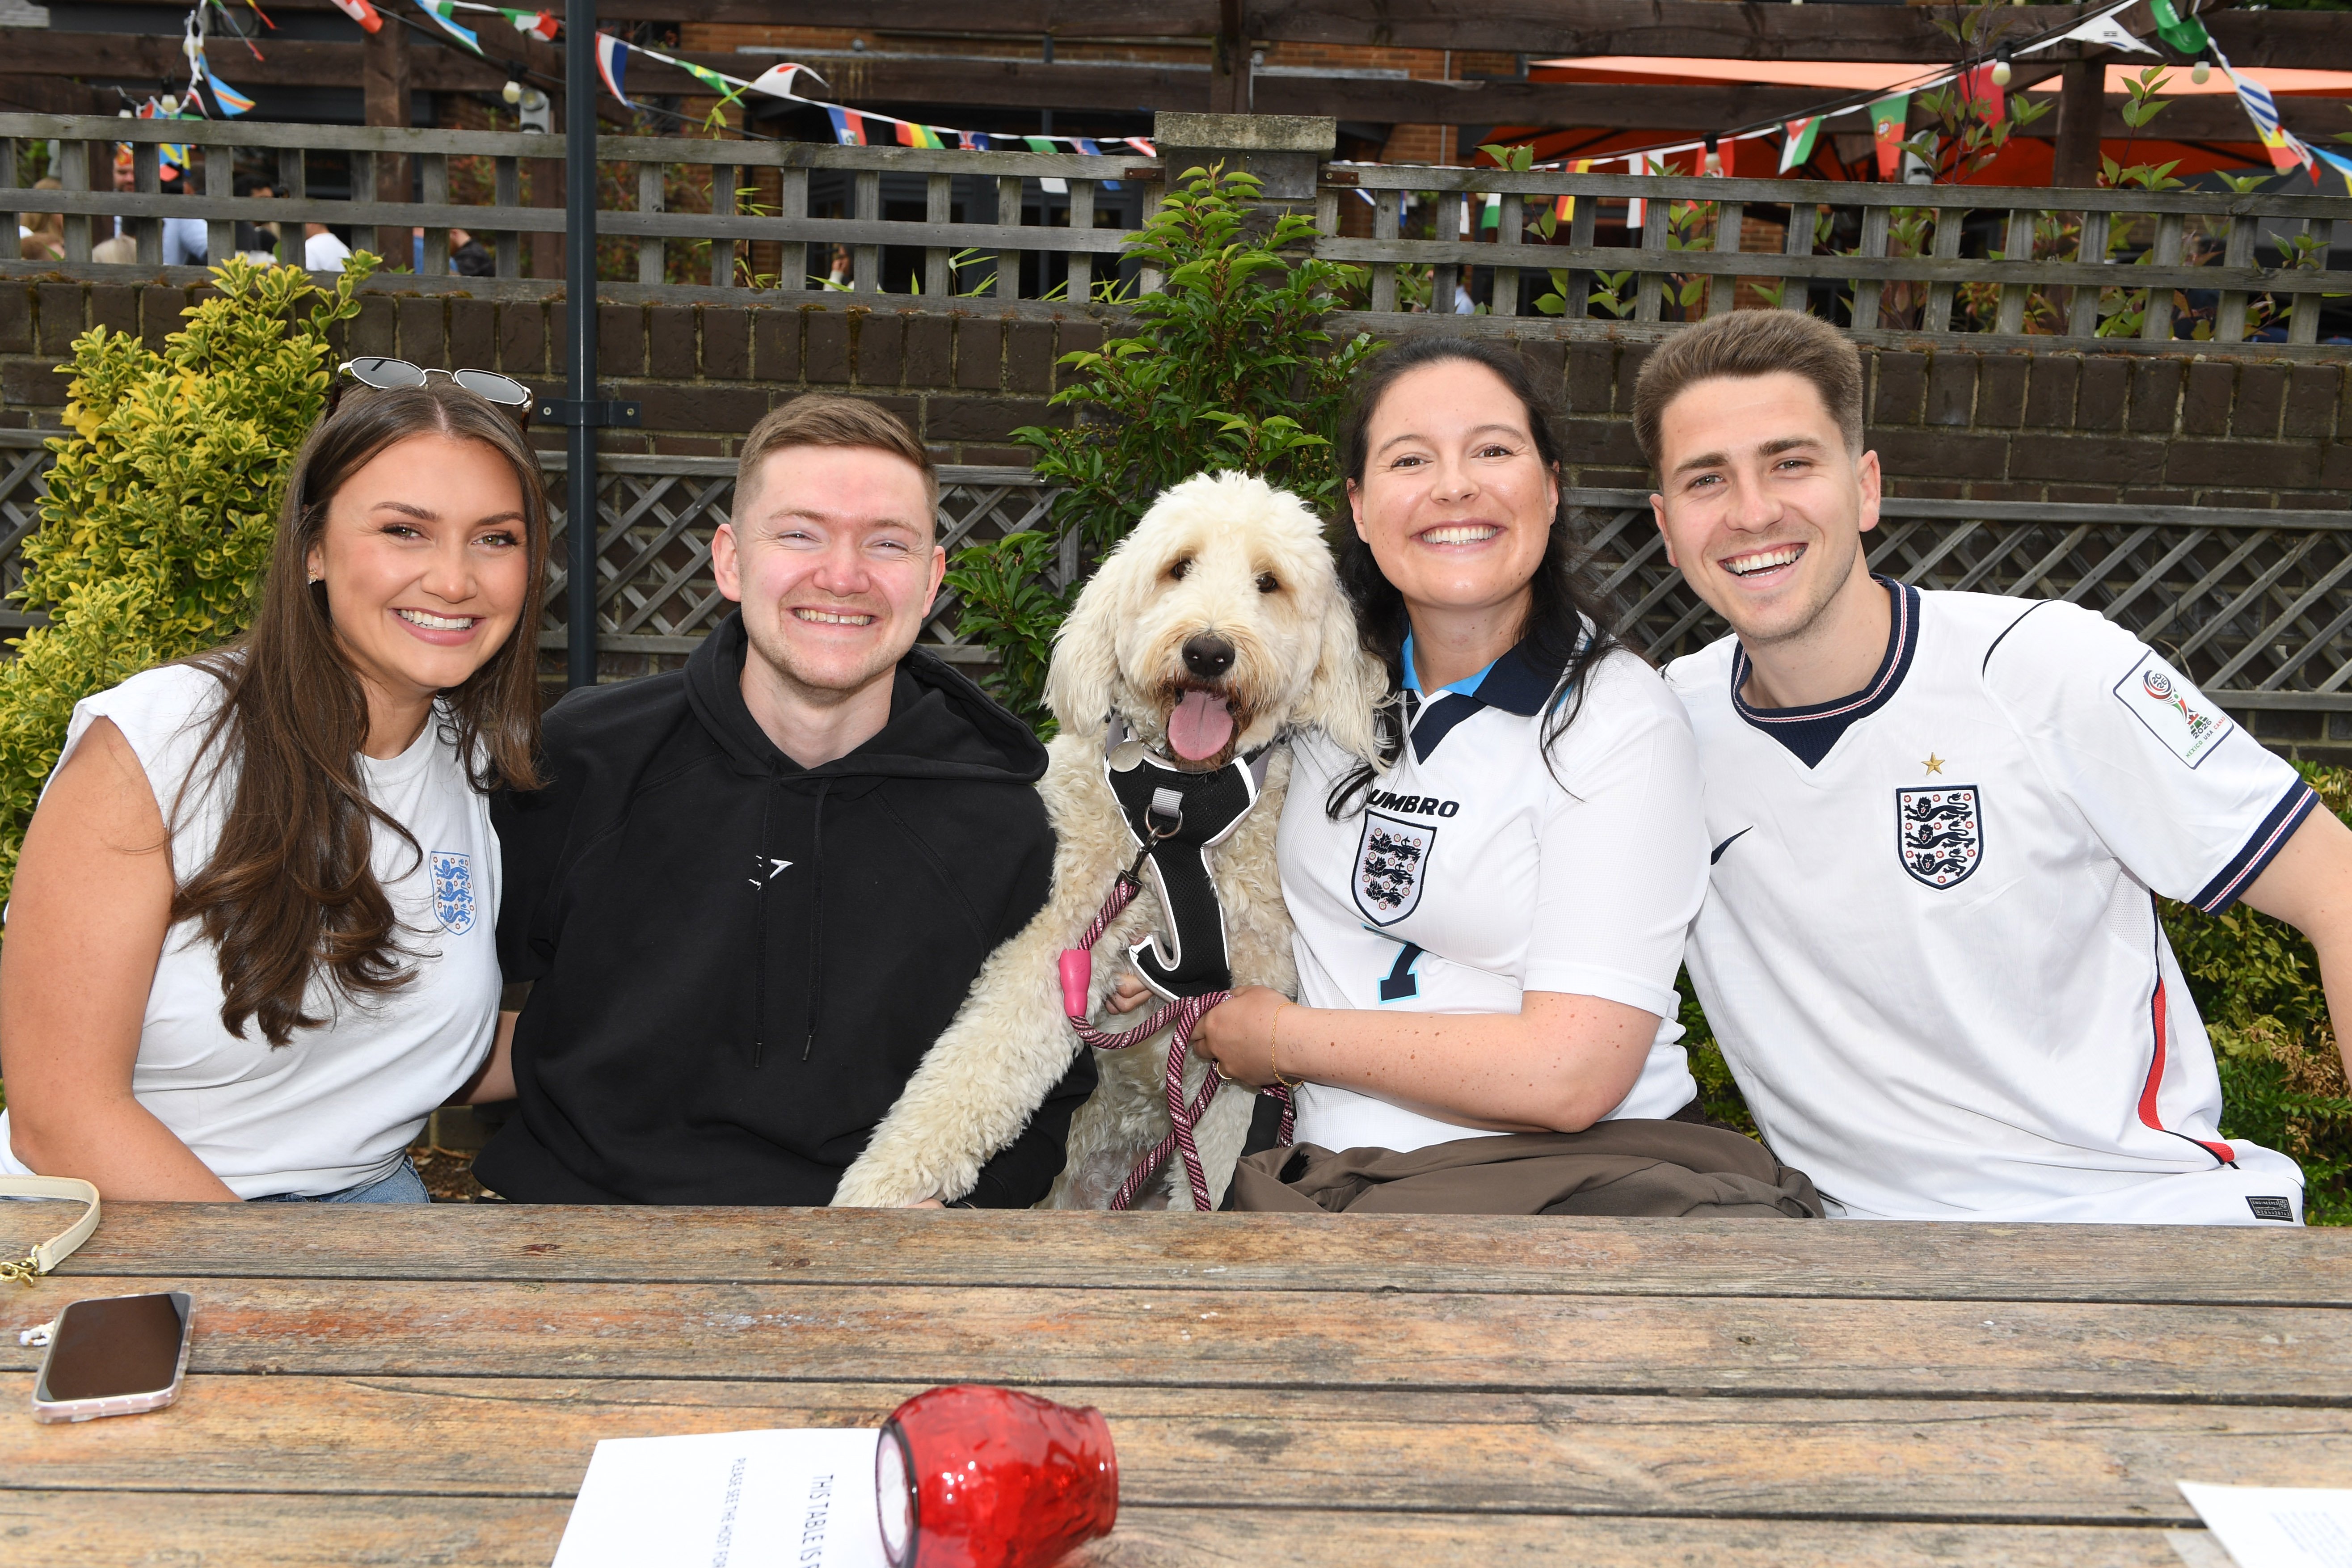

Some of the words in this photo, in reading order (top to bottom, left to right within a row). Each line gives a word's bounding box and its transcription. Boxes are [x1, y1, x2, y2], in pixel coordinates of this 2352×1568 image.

[2152, 673, 2162, 684] 20
[2157, 678, 2167, 688] 26
[2192, 719, 2212, 739] 2026
[2185, 740, 2203, 759] MEXICO
[2203, 730, 2214, 740] USA
[1367, 788, 1460, 818] UMBRO
[1361, 923, 1425, 1004] 7
[729, 1458, 747, 1488] PLEASE
[725, 1488, 740, 1504] SEE
[809, 1474, 834, 1500] THIS
[721, 1505, 737, 1523] THE
[802, 1502, 829, 1545] TABLE
[716, 1524, 733, 1549] HOST
[800, 1546, 822, 1561] IS
